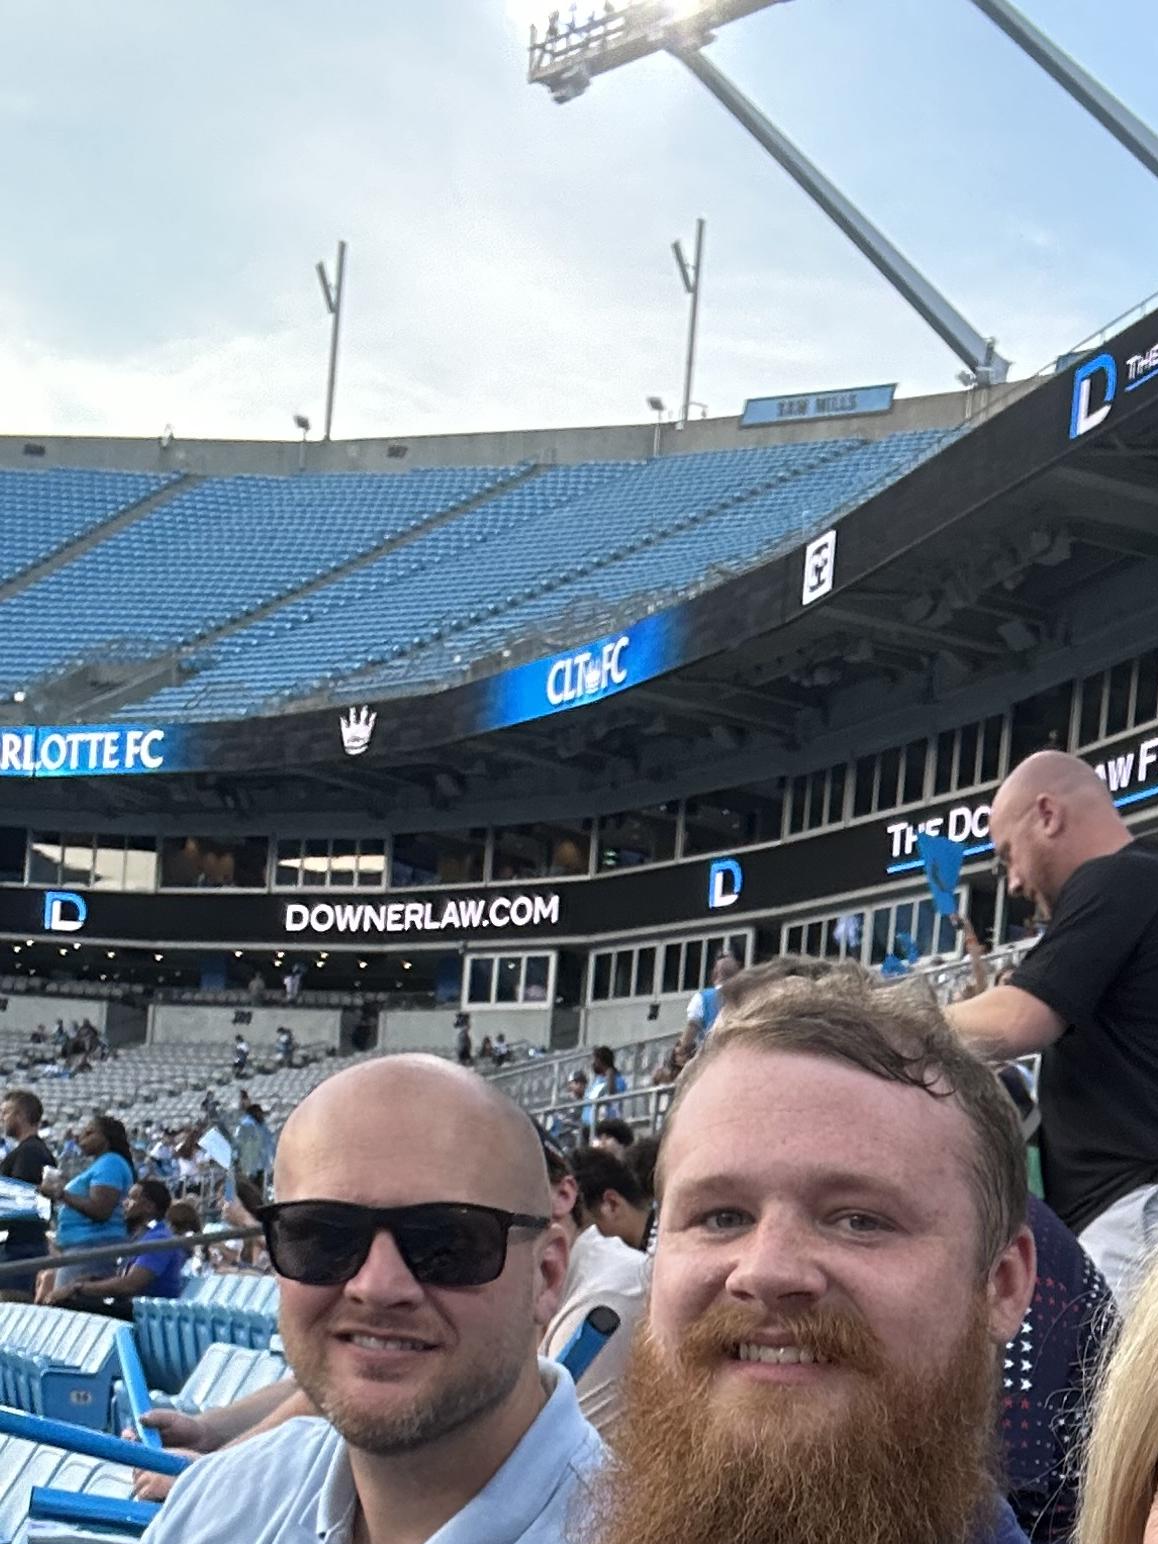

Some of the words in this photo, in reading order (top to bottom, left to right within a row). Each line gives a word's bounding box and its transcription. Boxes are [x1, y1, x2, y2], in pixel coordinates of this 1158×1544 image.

[600, 636, 630, 689] FC
[0, 731, 121, 771] RLOTTE
[125, 729, 165, 769] FC
[285, 894, 560, 933] DOWNERLAW.COM
